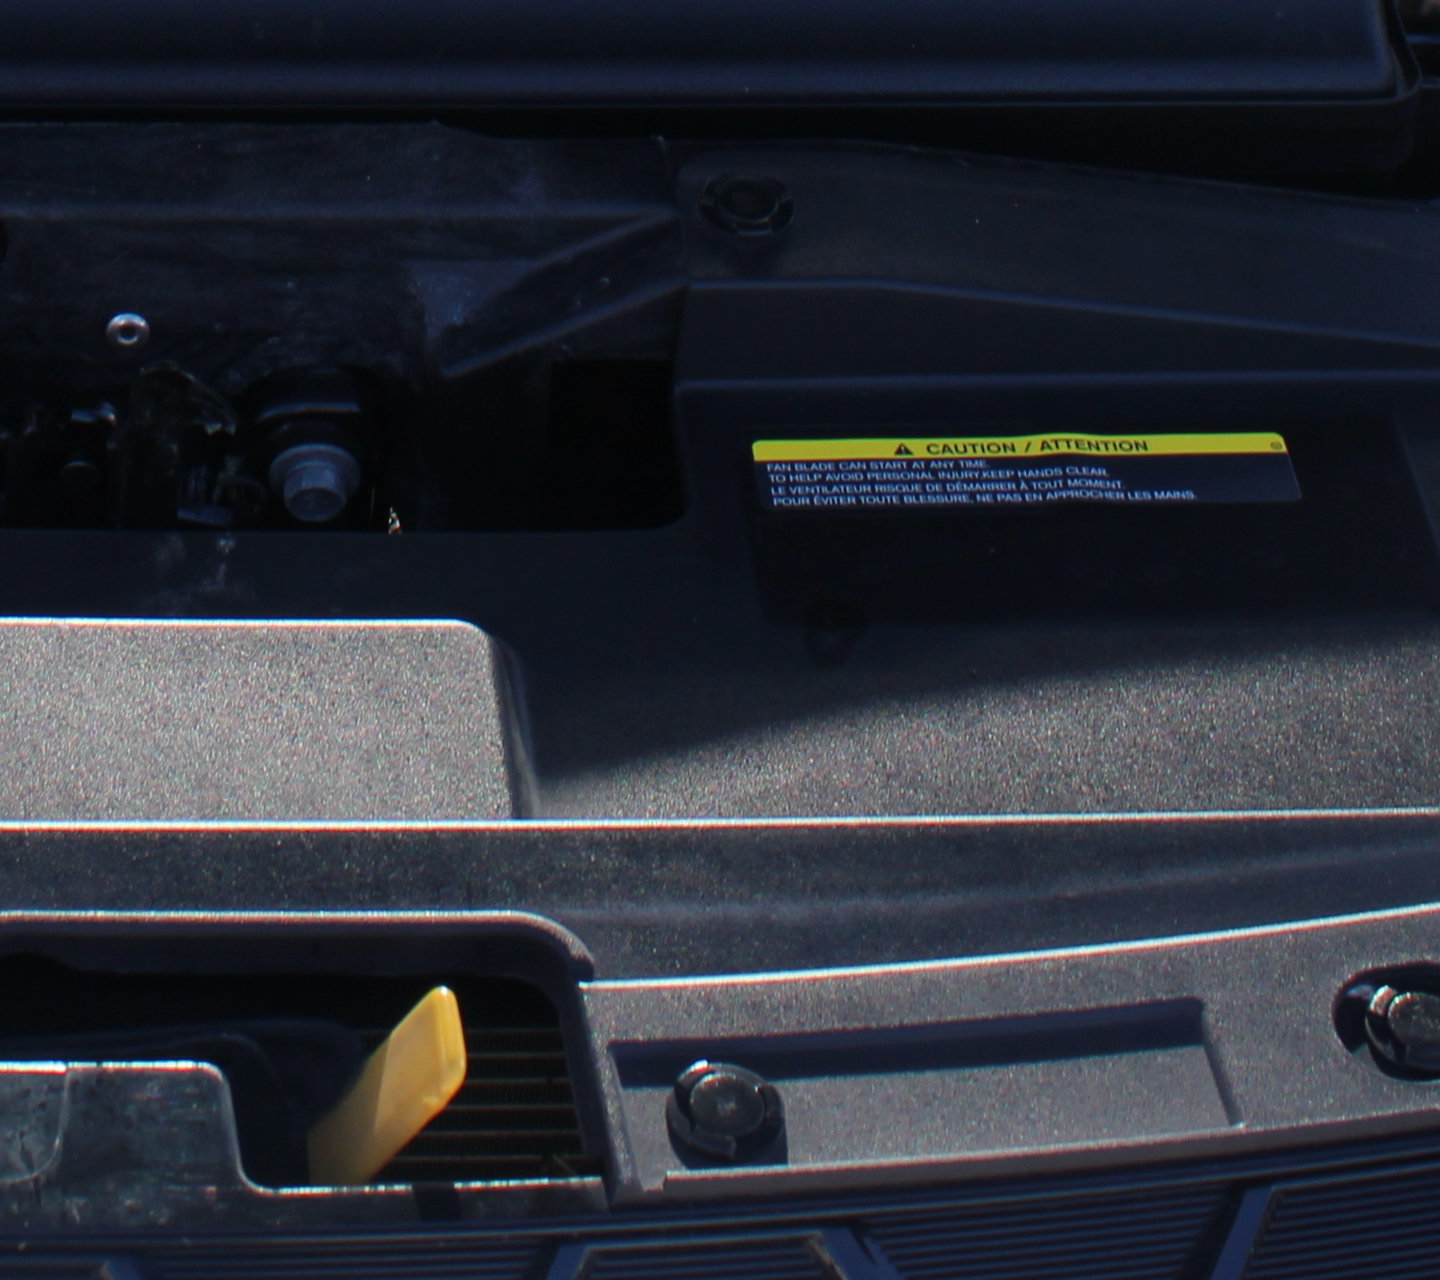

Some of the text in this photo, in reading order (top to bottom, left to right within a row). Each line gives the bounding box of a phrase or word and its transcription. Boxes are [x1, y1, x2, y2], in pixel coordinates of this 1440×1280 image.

[926, 442, 1016, 455] CAUTION
[1040, 439, 1148, 451] ATTENTION
[767, 462, 791, 472] FAN
[795, 462, 835, 472] BLADE
[839, 461, 866, 471] CAN
[870, 461, 907, 470] START
[911, 460, 924, 470] AT
[929, 460, 954, 469] ANY
[769, 474, 786, 483] TO
[790, 473, 821, 483] HELP
[825, 472, 863, 482] AVOID
[867, 471, 935, 481] PERSONAL
[1018, 467, 1063, 478] HANDS
[771, 486, 788, 495] LE
[791, 484, 873, 495] VENTILATEUR
[875, 483, 922, 493] RISQUE
[925, 483, 942, 492] DE
[1032, 479, 1064, 490] TOUT
[773, 496, 810, 506] POUR
[860, 495, 901, 505] TOUTE
[976, 493, 993, 503] NE
[997, 492, 1022, 502] PAS
[1025, 492, 1043, 501] EN
[1046, 489, 1125, 501] APPROCHER
[1128, 490, 1151, 500] LES
